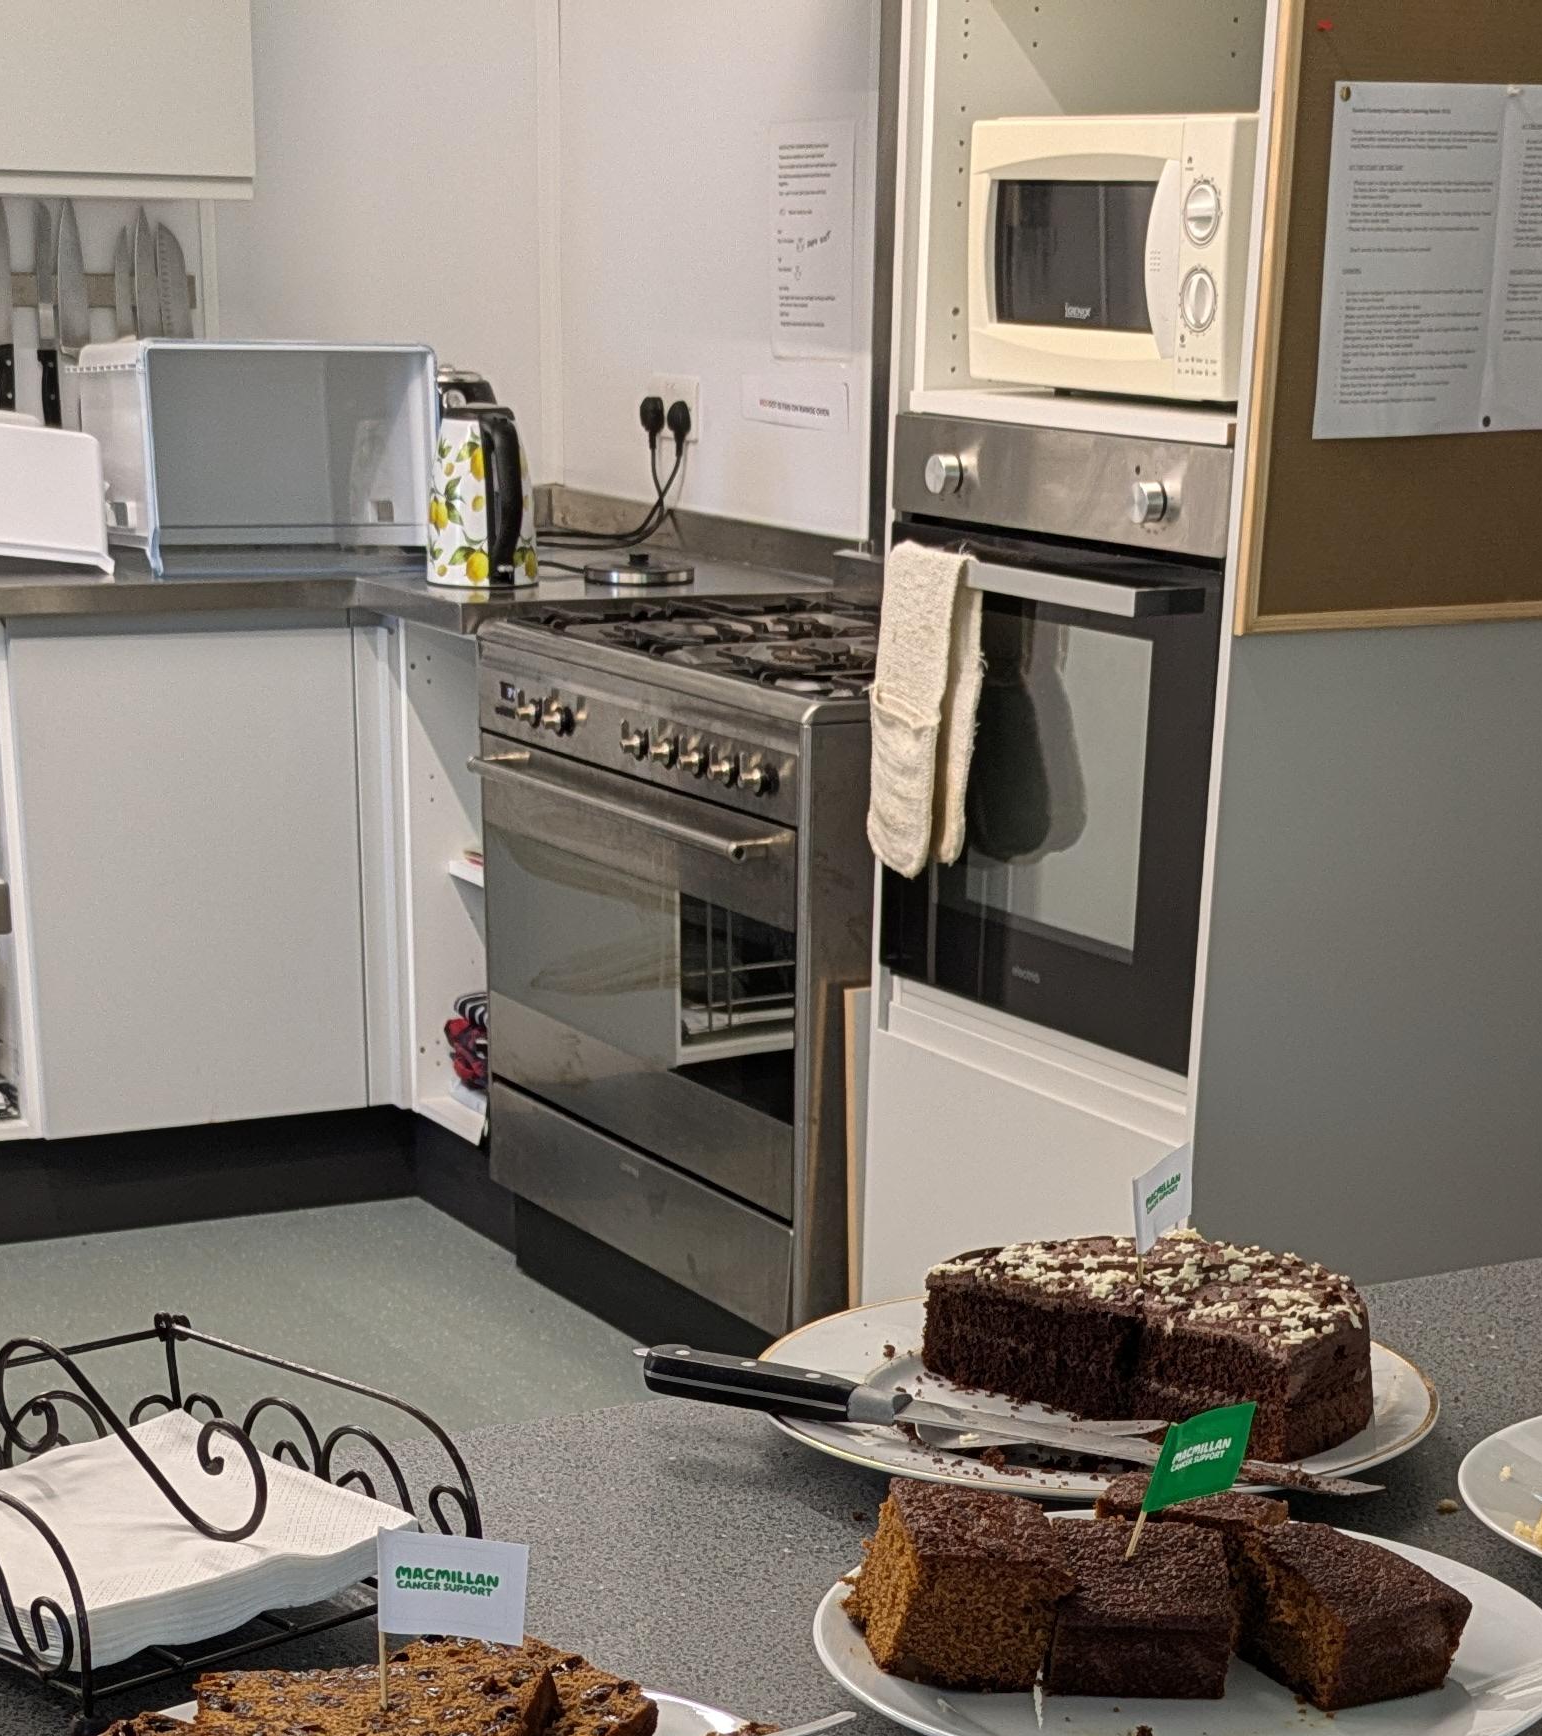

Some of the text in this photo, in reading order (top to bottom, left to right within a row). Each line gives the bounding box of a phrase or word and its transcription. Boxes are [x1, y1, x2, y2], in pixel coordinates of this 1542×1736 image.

[1171, 1436, 1232, 1465] MACMILLAN
[1193, 1449, 1226, 1464] SUPPORT
[395, 1565, 500, 1588] MACMILLAN
[396, 1579, 493, 1597] CANCER SUPPORT
